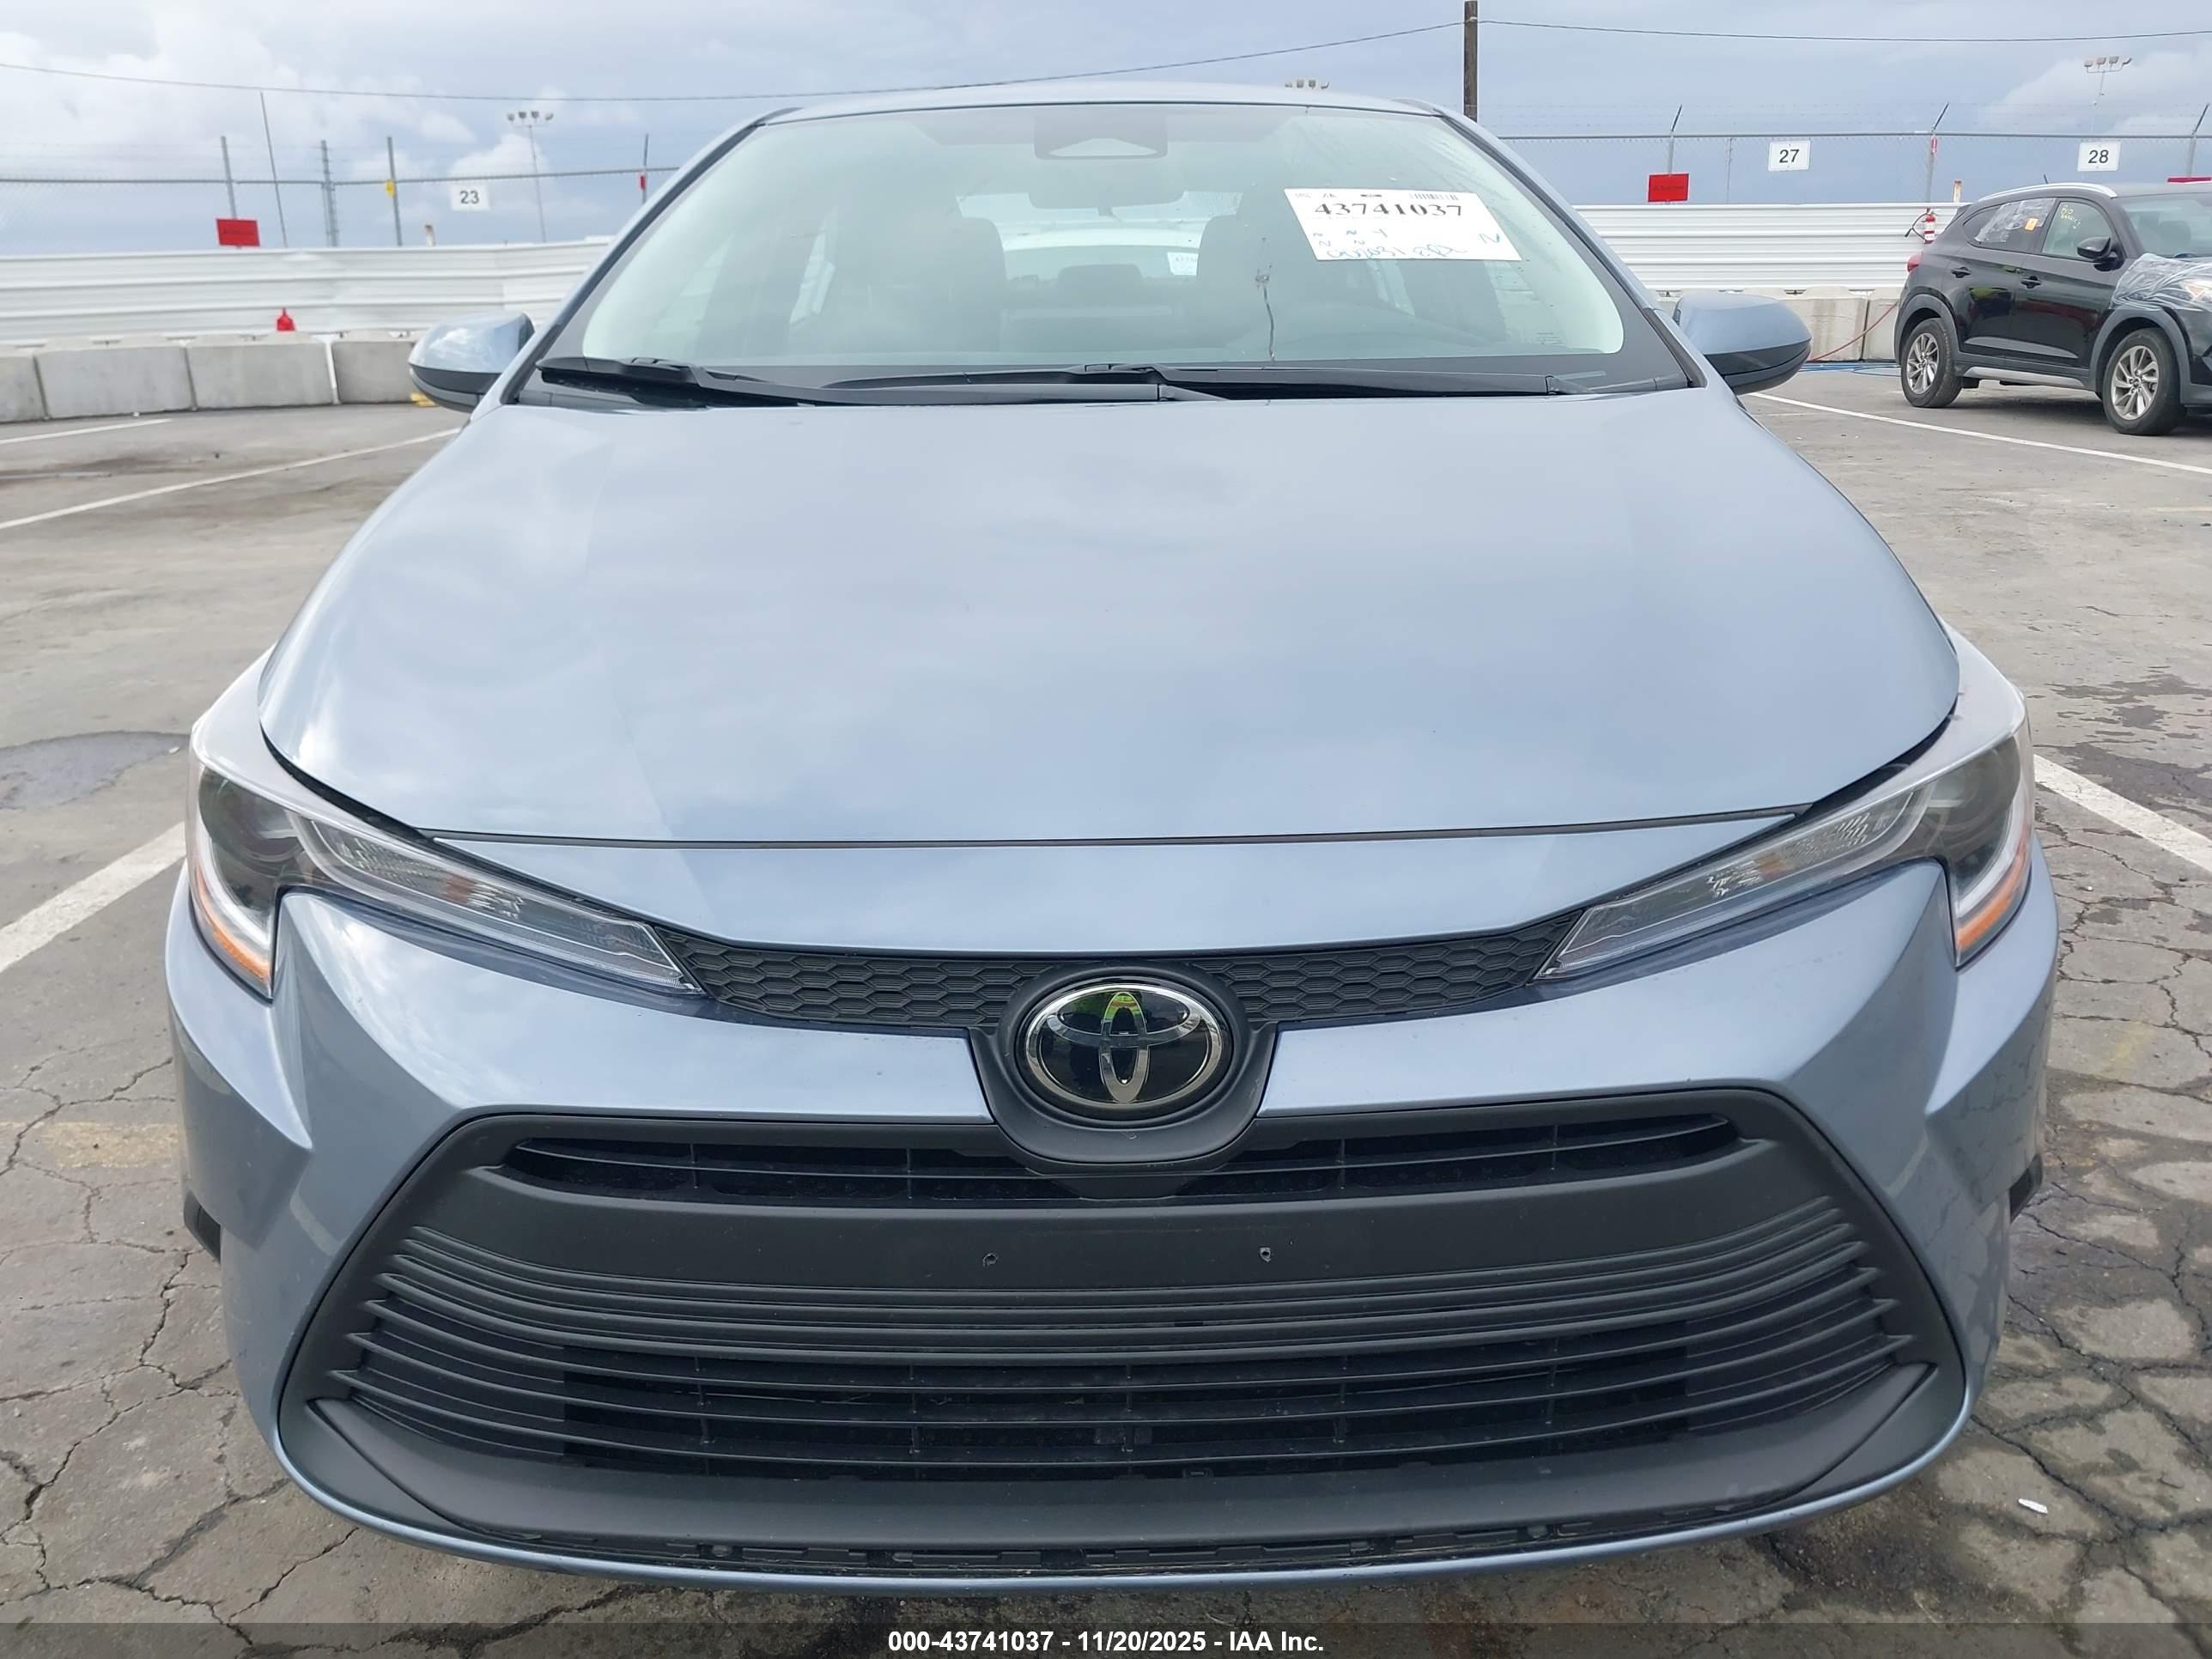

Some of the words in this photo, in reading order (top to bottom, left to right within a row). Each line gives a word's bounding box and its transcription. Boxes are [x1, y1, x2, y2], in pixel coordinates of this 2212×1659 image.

[1778, 149, 1800, 163] 27
[2087, 149, 2109, 164] 28
[459, 191, 479, 204] 23
[1314, 203, 1462, 216] 43741037
